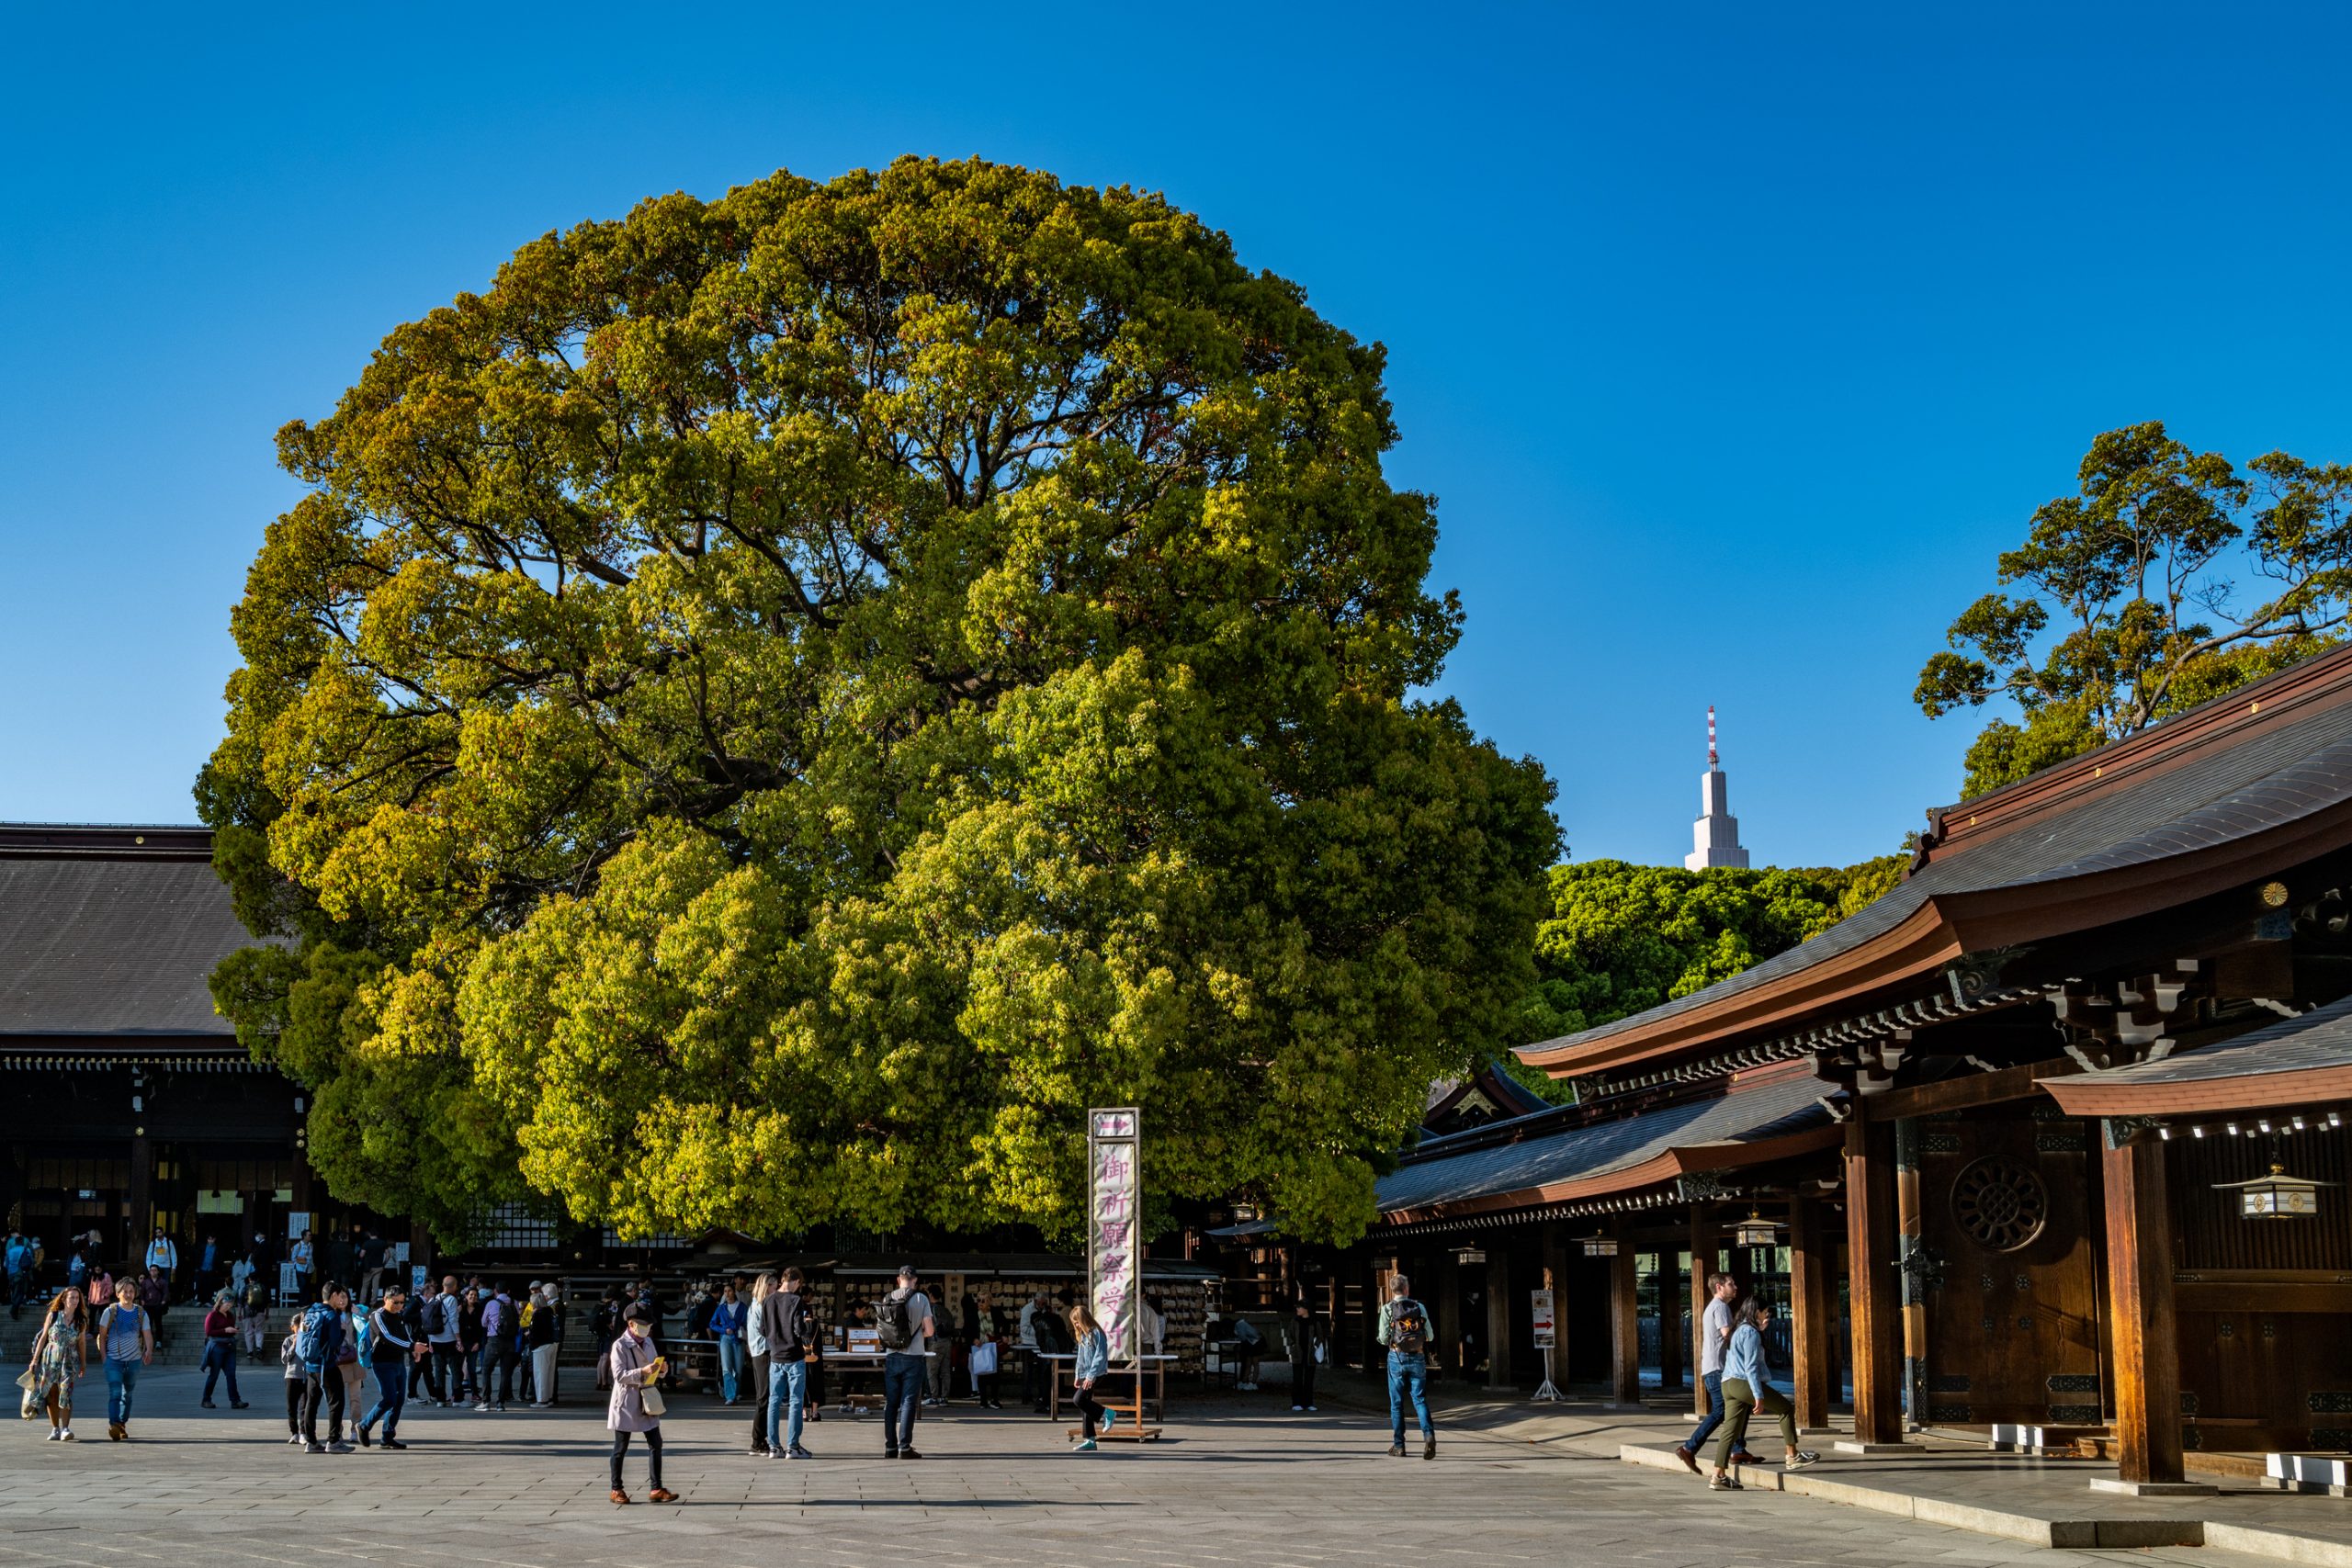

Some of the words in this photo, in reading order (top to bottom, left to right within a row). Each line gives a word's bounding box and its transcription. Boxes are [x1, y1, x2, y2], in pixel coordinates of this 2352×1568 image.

[1101, 1154, 1129, 1349] 御祈願祭受付
